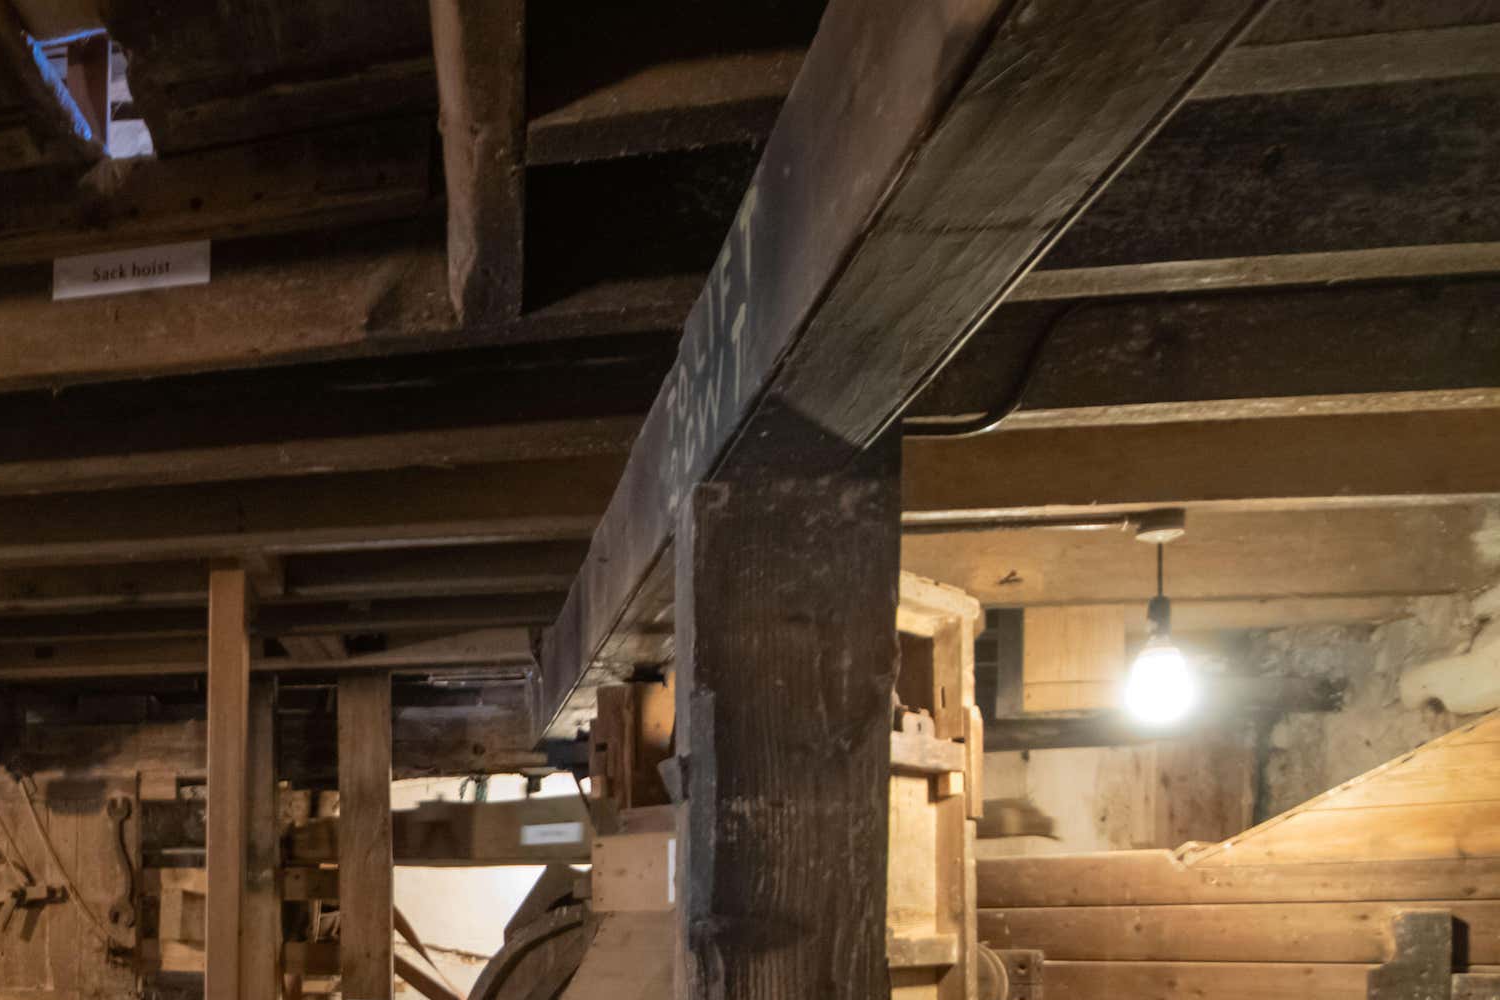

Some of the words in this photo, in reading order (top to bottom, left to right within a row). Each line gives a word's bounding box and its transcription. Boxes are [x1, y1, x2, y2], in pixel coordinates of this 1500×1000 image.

[92, 262, 126, 282] Sack
[131, 258, 171, 278] hoist
[693, 184, 758, 374] LIFT
